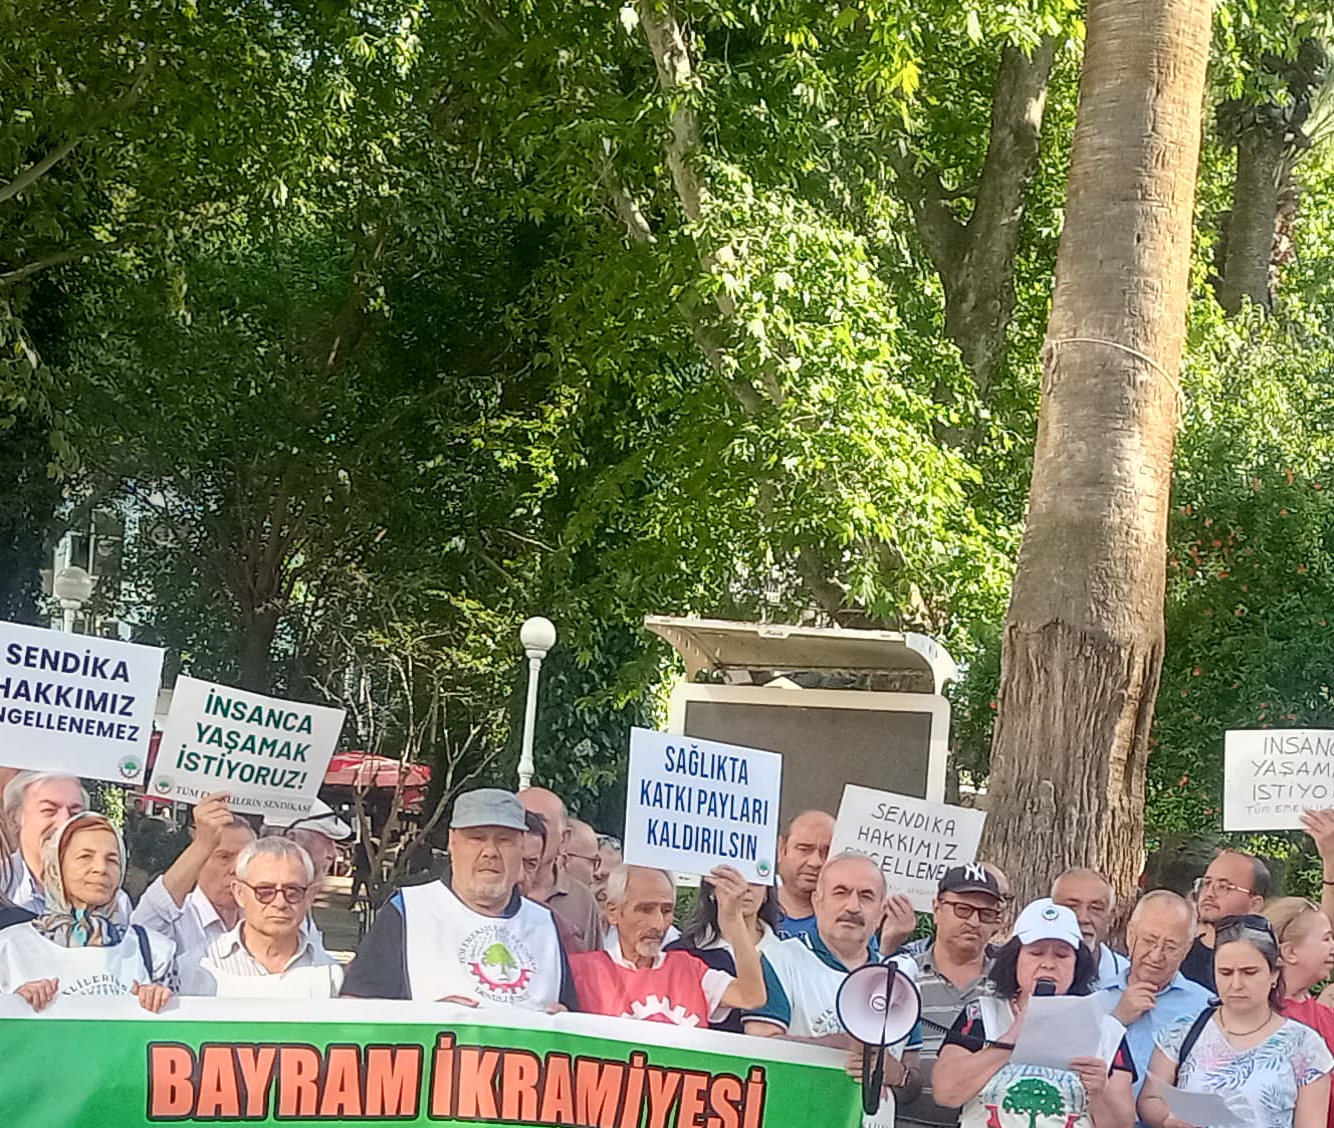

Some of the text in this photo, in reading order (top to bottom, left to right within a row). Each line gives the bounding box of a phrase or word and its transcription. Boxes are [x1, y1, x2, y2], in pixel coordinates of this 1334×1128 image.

[6, 643, 130, 683] SENDİKA
[204, 693, 313, 735] İNSANCA
[195, 721, 311, 763] YAŞAMAK
[176, 748, 308, 790] İSTİYORUZ!
[665, 744, 749, 786] SAĞLIKTA
[640, 779, 769, 826] KATKI PAYLARI
[647, 818, 758, 861] KALDIRILSIN
[149, 1044, 421, 1119] BAYRAM
